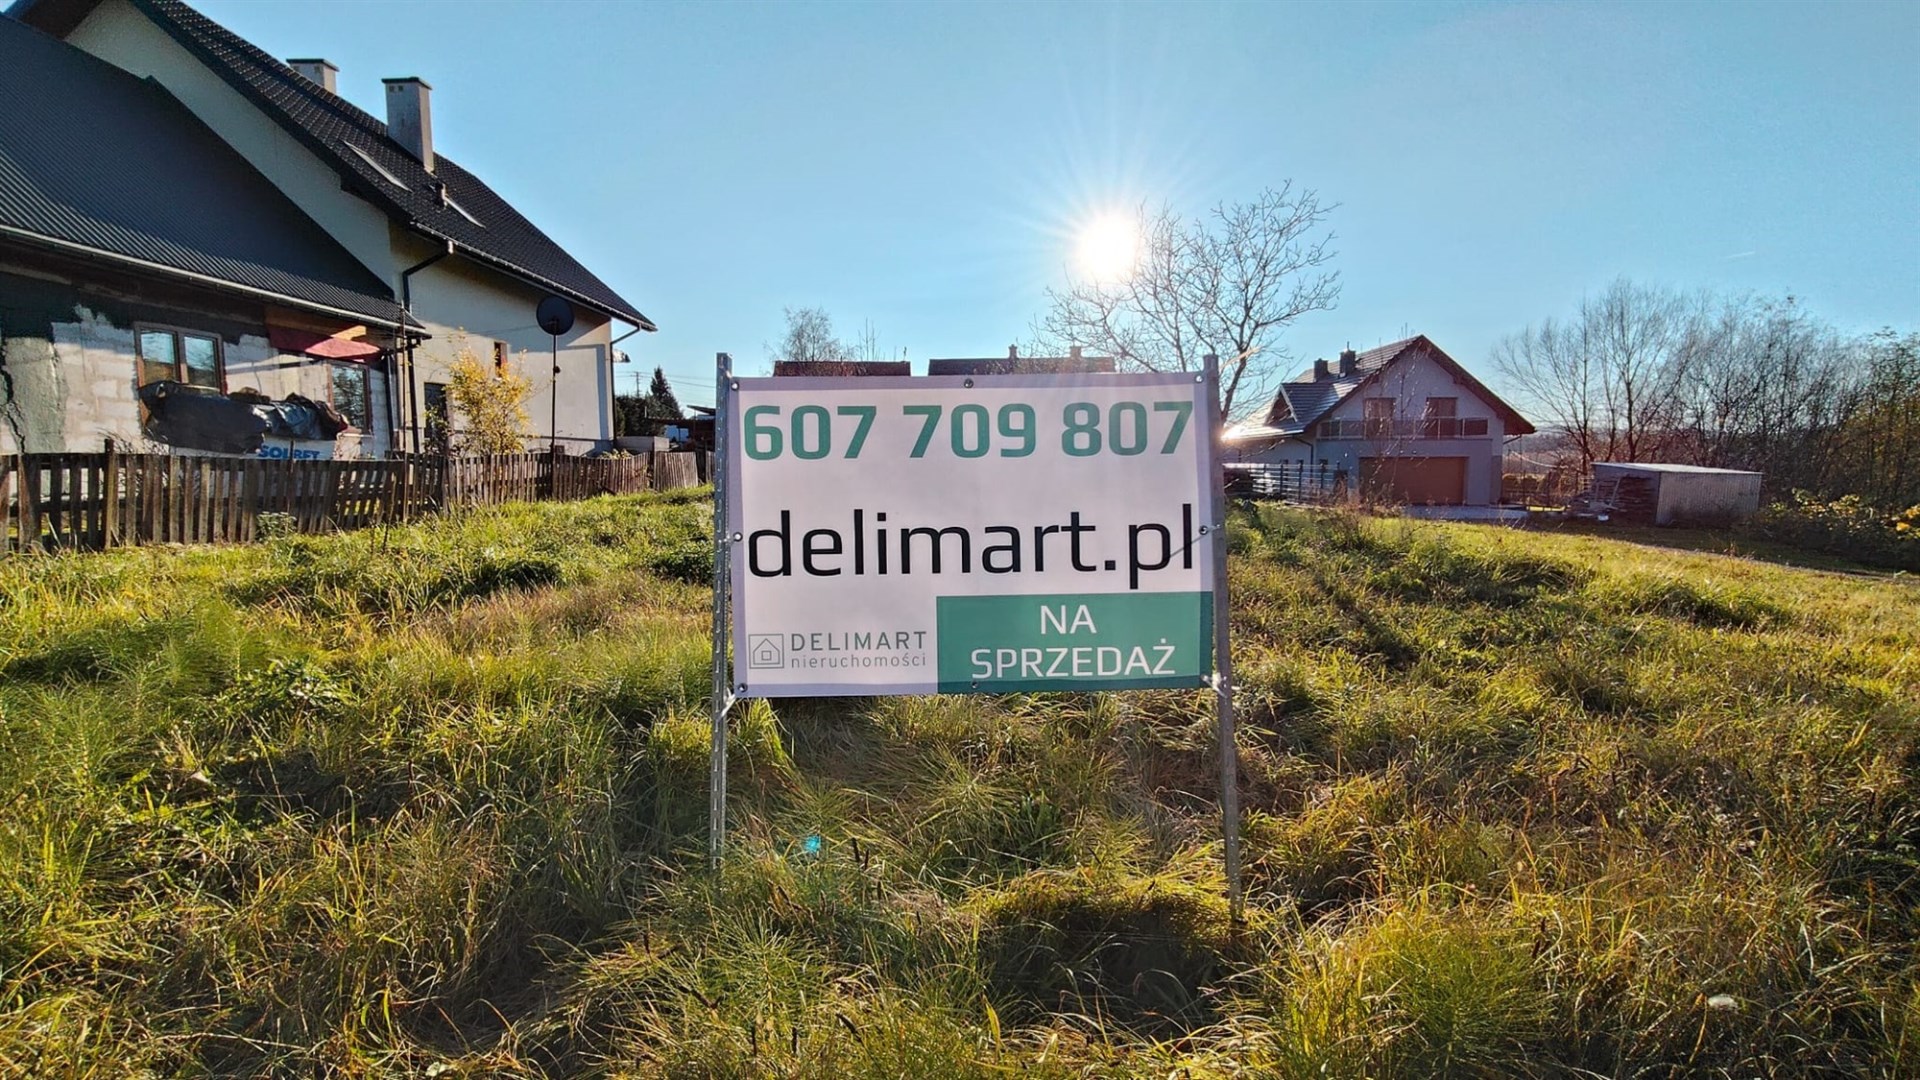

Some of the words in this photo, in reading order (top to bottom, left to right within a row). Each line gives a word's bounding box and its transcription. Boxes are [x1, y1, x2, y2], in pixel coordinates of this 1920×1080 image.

[743, 404, 877, 460] 607
[902, 403, 1037, 459] 709
[1061, 400, 1194, 457] 807
[748, 503, 1194, 590] delimart.pl
[1039, 604, 1097, 635] NA
[790, 631, 928, 651] DELIMART
[970, 638, 1176, 680] SPRZEDAŻ
[790, 653, 927, 669] nieruchomości
